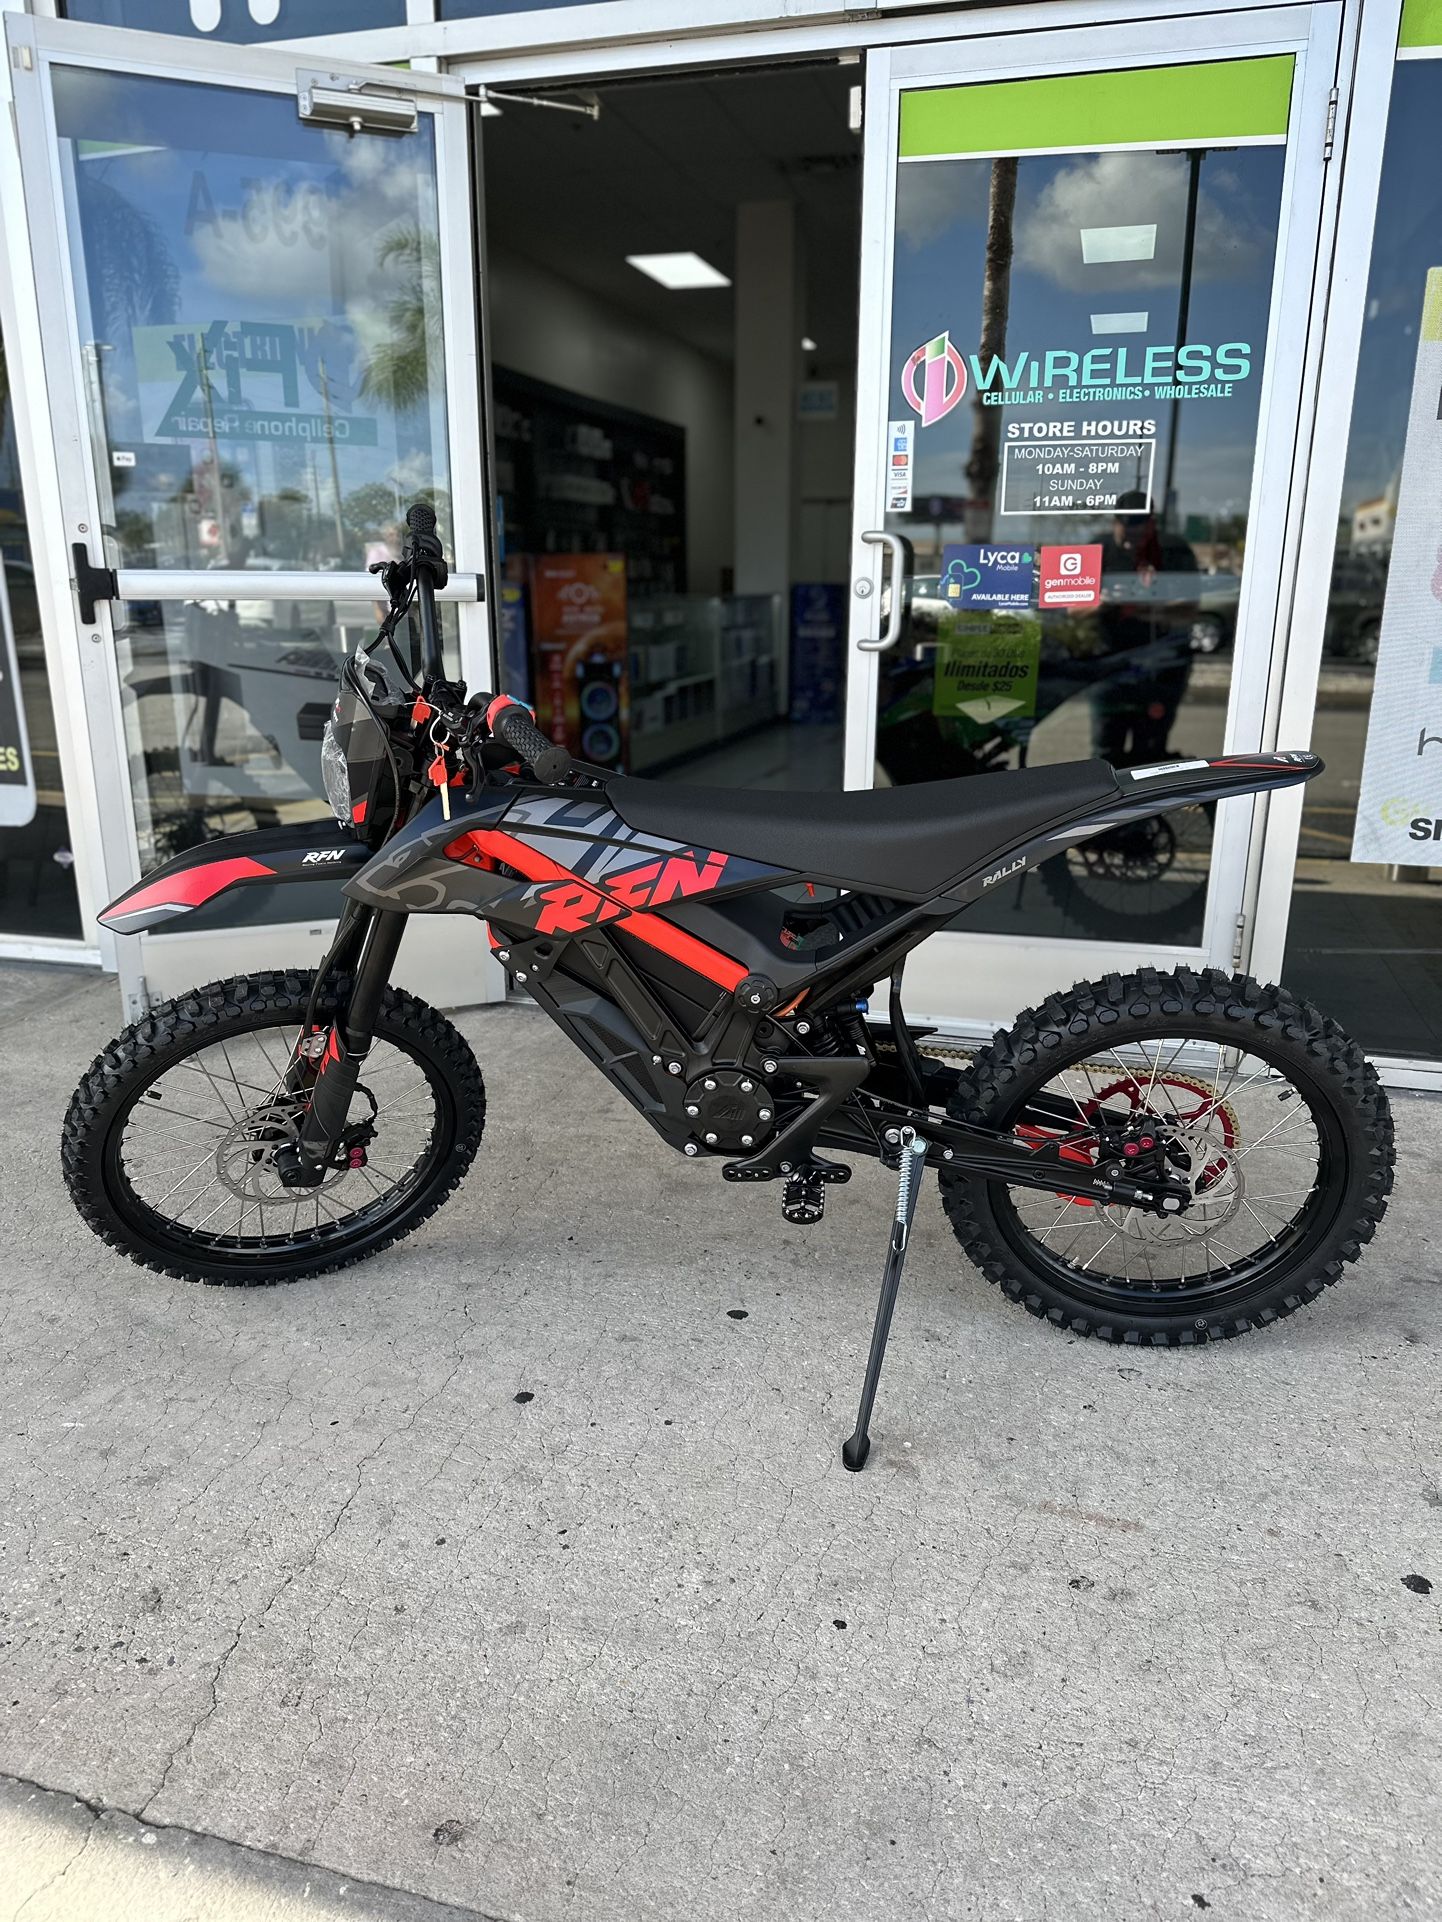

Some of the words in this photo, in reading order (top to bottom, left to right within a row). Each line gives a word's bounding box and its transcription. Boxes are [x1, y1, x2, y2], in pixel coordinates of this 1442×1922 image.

[983, 390, 1043, 405] CELLULAR
[1059, 387, 1143, 402] ELECTRONICS
[1155, 384, 1232, 399] WHOLESALE
[1007, 422, 1075, 438] STORE
[1082, 419, 1156, 436] HOURS
[1014, 446, 1145, 459] MONDAY-SATURDAY
[1036, 463, 1075, 474] 10AM
[1088, 462, 1120, 473] 8PM
[1049, 479, 1104, 490] SUNDAY
[1034, 496, 1073, 507] 11AM
[1086, 495, 1117, 506] 6PM
[979, 549, 1020, 566] Lyca
[1045, 576, 1096, 589] genmobile
[944, 660, 1030, 679] Ilimitados
[957, 680, 990, 692] Desde
[991, 680, 1014, 693] $25
[302, 849, 346, 863] RFN
[982, 856, 1026, 888] RALLY
